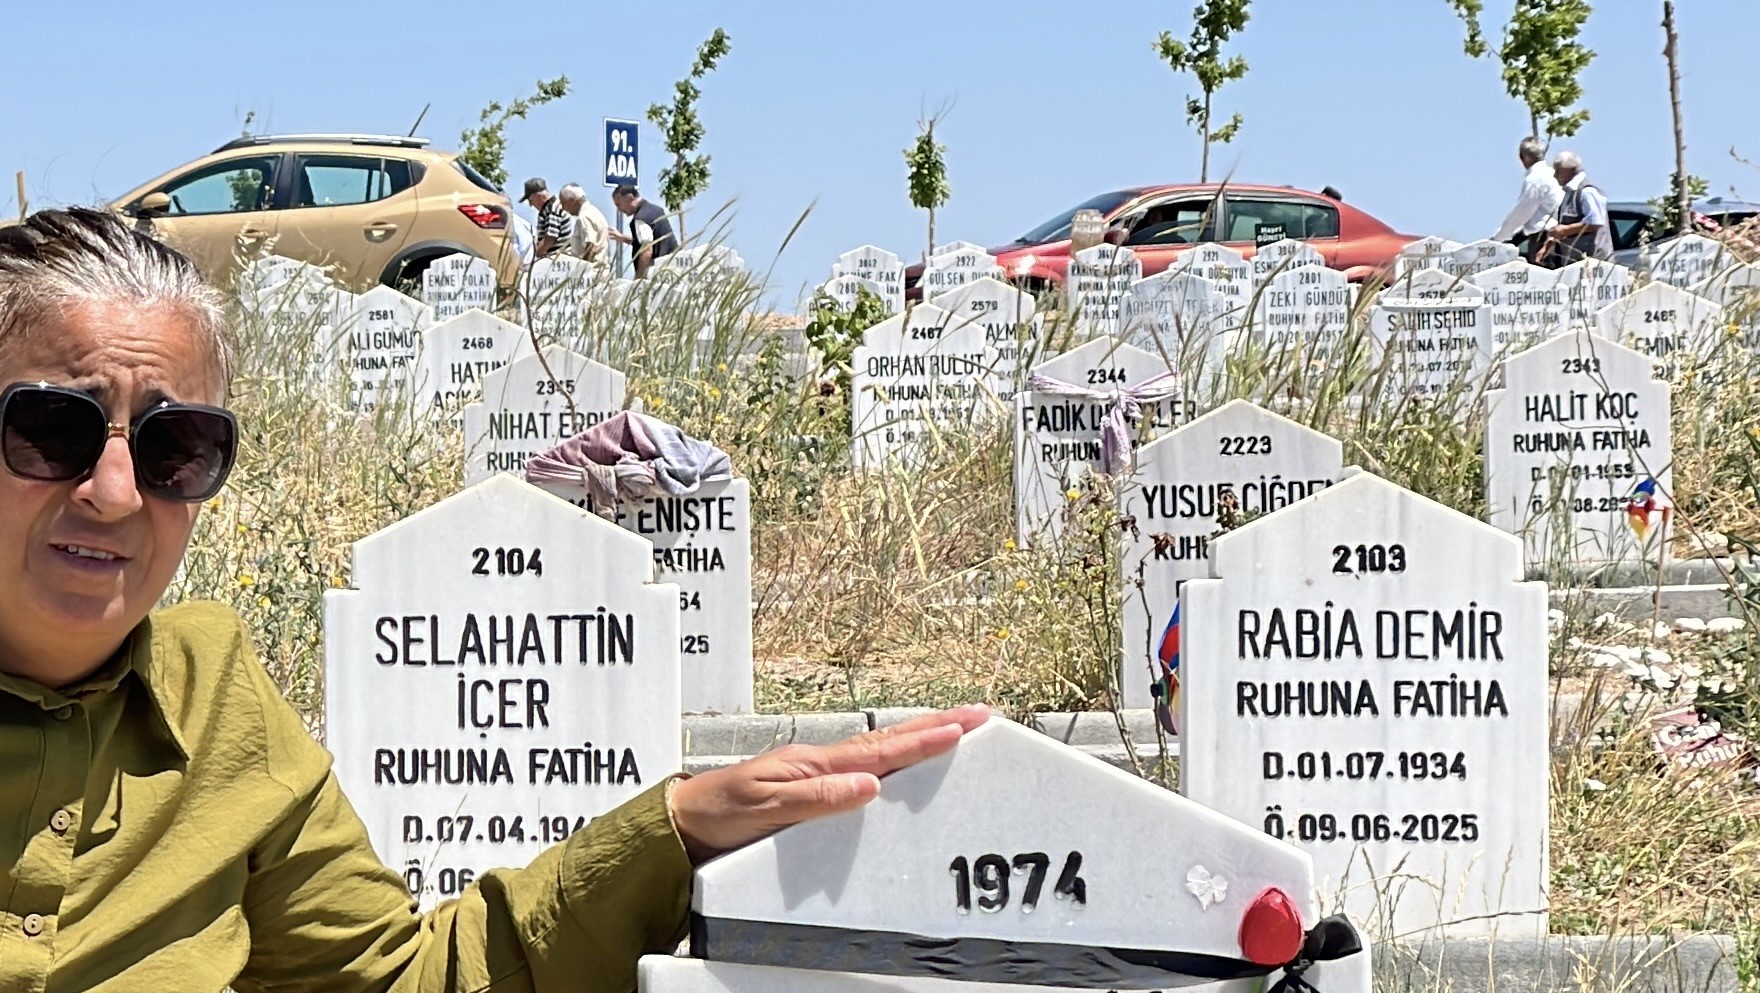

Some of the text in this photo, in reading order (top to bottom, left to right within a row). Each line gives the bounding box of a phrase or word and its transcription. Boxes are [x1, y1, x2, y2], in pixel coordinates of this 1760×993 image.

[611, 129, 633, 152] 91.
[607, 155, 637, 178] ADA
[368, 309, 395, 322] 2581
[1314, 311, 1347, 327] FATİH
[462, 337, 494, 350] 2468
[867, 354, 926, 378] ORHAN
[1087, 367, 1127, 384] 2344
[1022, 399, 1087, 433] FADİK
[1525, 389, 1639, 426] HALİT KOÇ
[489, 407, 552, 441] NİHAT
[1041, 441, 1102, 463] RUHUN
[1219, 435, 1273, 457] 2223
[1512, 430, 1586, 453] RUHUNA
[486, 451, 535, 472] RUH
[470, 546, 544, 578] 2104
[653, 542, 726, 573] FATİHA
[1331, 543, 1408, 577] 2103
[374, 605, 635, 668] SELAHATTİN
[1238, 599, 1505, 662] RABİA DEMİR
[456, 671, 551, 739] İÇER
[1236, 671, 1510, 719] RUHUNA FATİHA
[373, 740, 642, 787] RUHUNA FATİHA
[1262, 750, 1468, 782] D.01.07.1934
[402, 814, 600, 846] D.07.04.19
[1263, 804, 1480, 843] Ö.09.06.2025
[948, 850, 1089, 916] 1974
